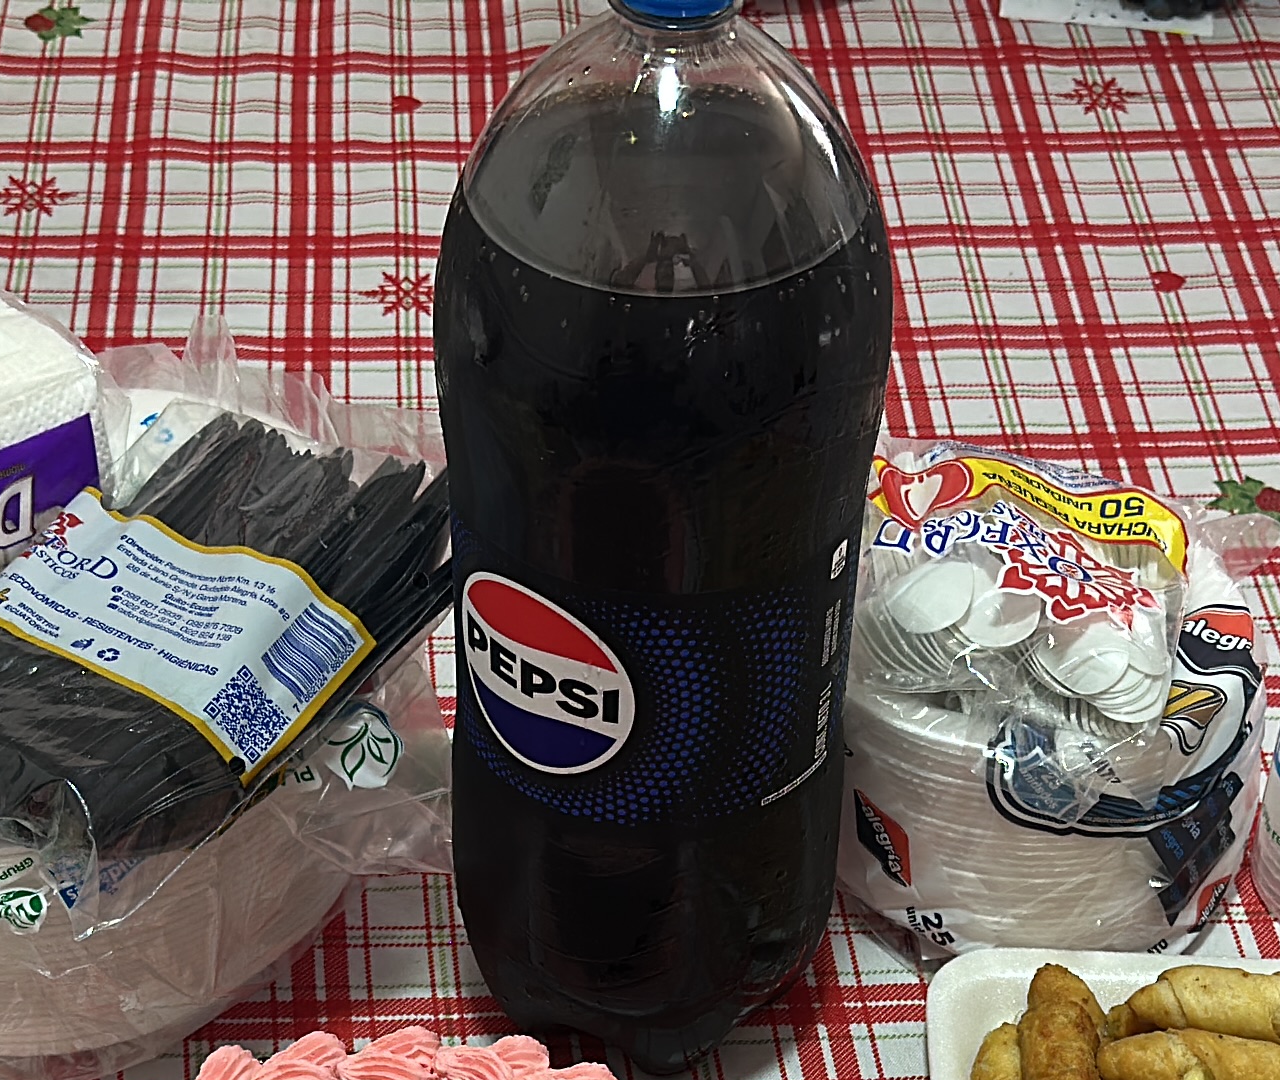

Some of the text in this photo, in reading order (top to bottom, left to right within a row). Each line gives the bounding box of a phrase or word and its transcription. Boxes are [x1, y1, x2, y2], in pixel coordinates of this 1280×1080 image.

[1010, 469, 1146, 519] 50 UNIDADES
[4, 604, 60, 639] ECUATORIANA
[8, 572, 219, 676] ECONÓMICAS RESISTENTES HIGIÉNICAS
[18, 603, 60, 632] INDUSTRIA
[467, 609, 620, 724] PEPSI
[862, 805, 903, 873] alegría
[921, 912, 955, 947] 25
